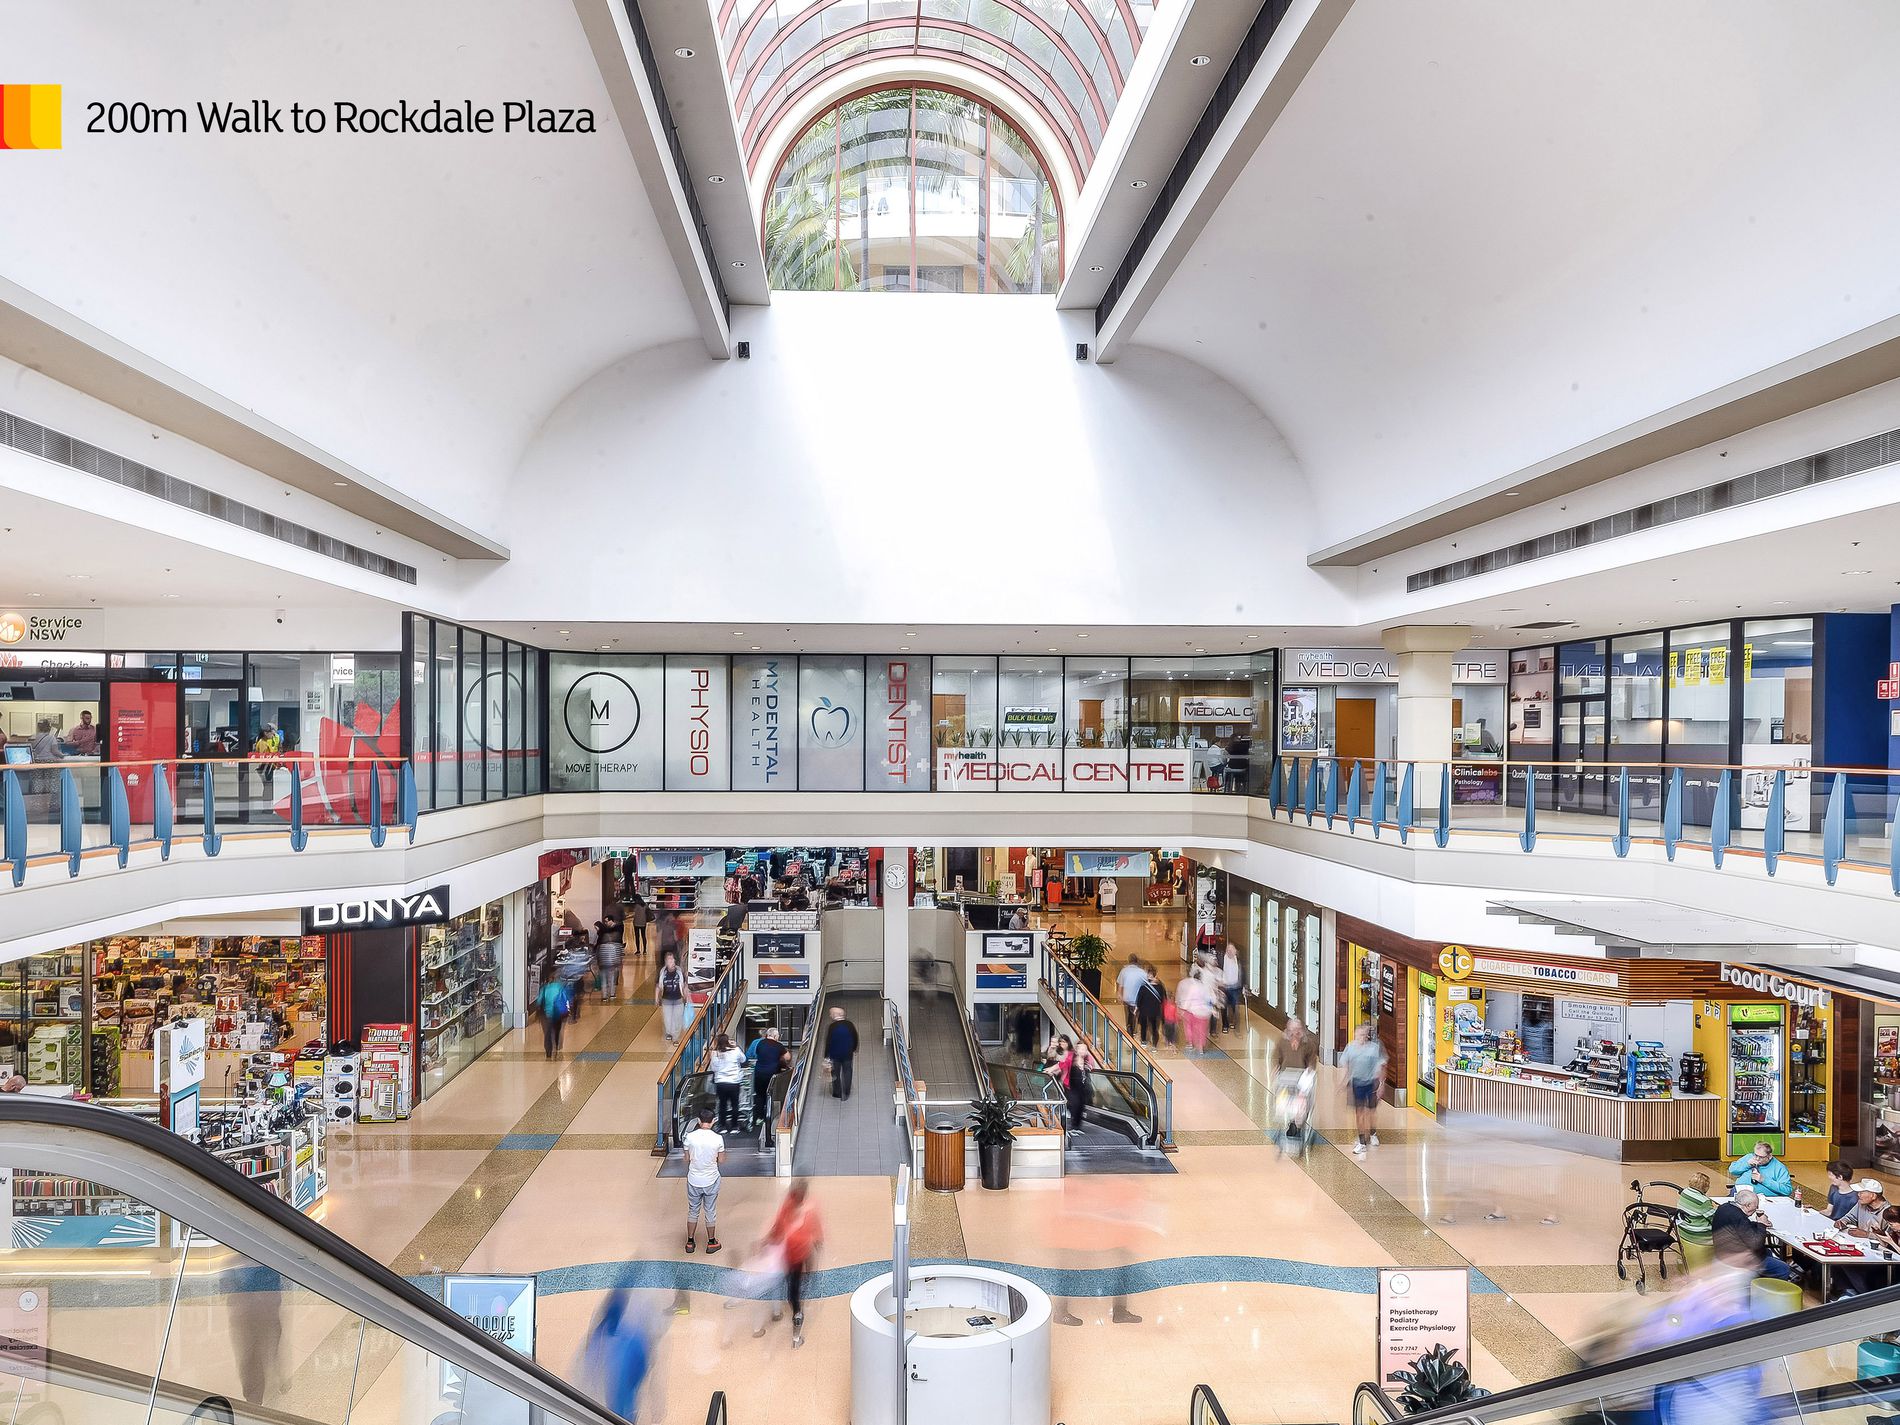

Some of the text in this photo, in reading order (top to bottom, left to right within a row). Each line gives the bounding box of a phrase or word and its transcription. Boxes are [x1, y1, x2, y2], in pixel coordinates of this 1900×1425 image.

[30, 616, 83, 628] Service
[30, 629, 66, 641] NSW
[1298, 652, 1333, 661] myhealth
[1298, 662, 1497, 678] MEDICAL TRE
[590, 699, 610, 720] M
[1007, 713, 1054, 722] BULK BILLING
[1184, 708, 1241, 717] MEDICAL
[690, 670, 709, 776] PHYSIO
[751, 679, 760, 766] HEALTH
[888, 662, 907, 784] DENTIST
[944, 752, 987, 761] myhealth
[565, 763, 639, 773] MOVE THERAPY
[944, 763, 1184, 781] MEDICAL CENTRE
[313, 893, 443, 927] DONYA
[1440, 947, 1471, 974] ctc
[1481, 960, 1611, 984] CIGARETTES TOBACCO CIGARS
[1720, 962, 1828, 1009] Food Court
